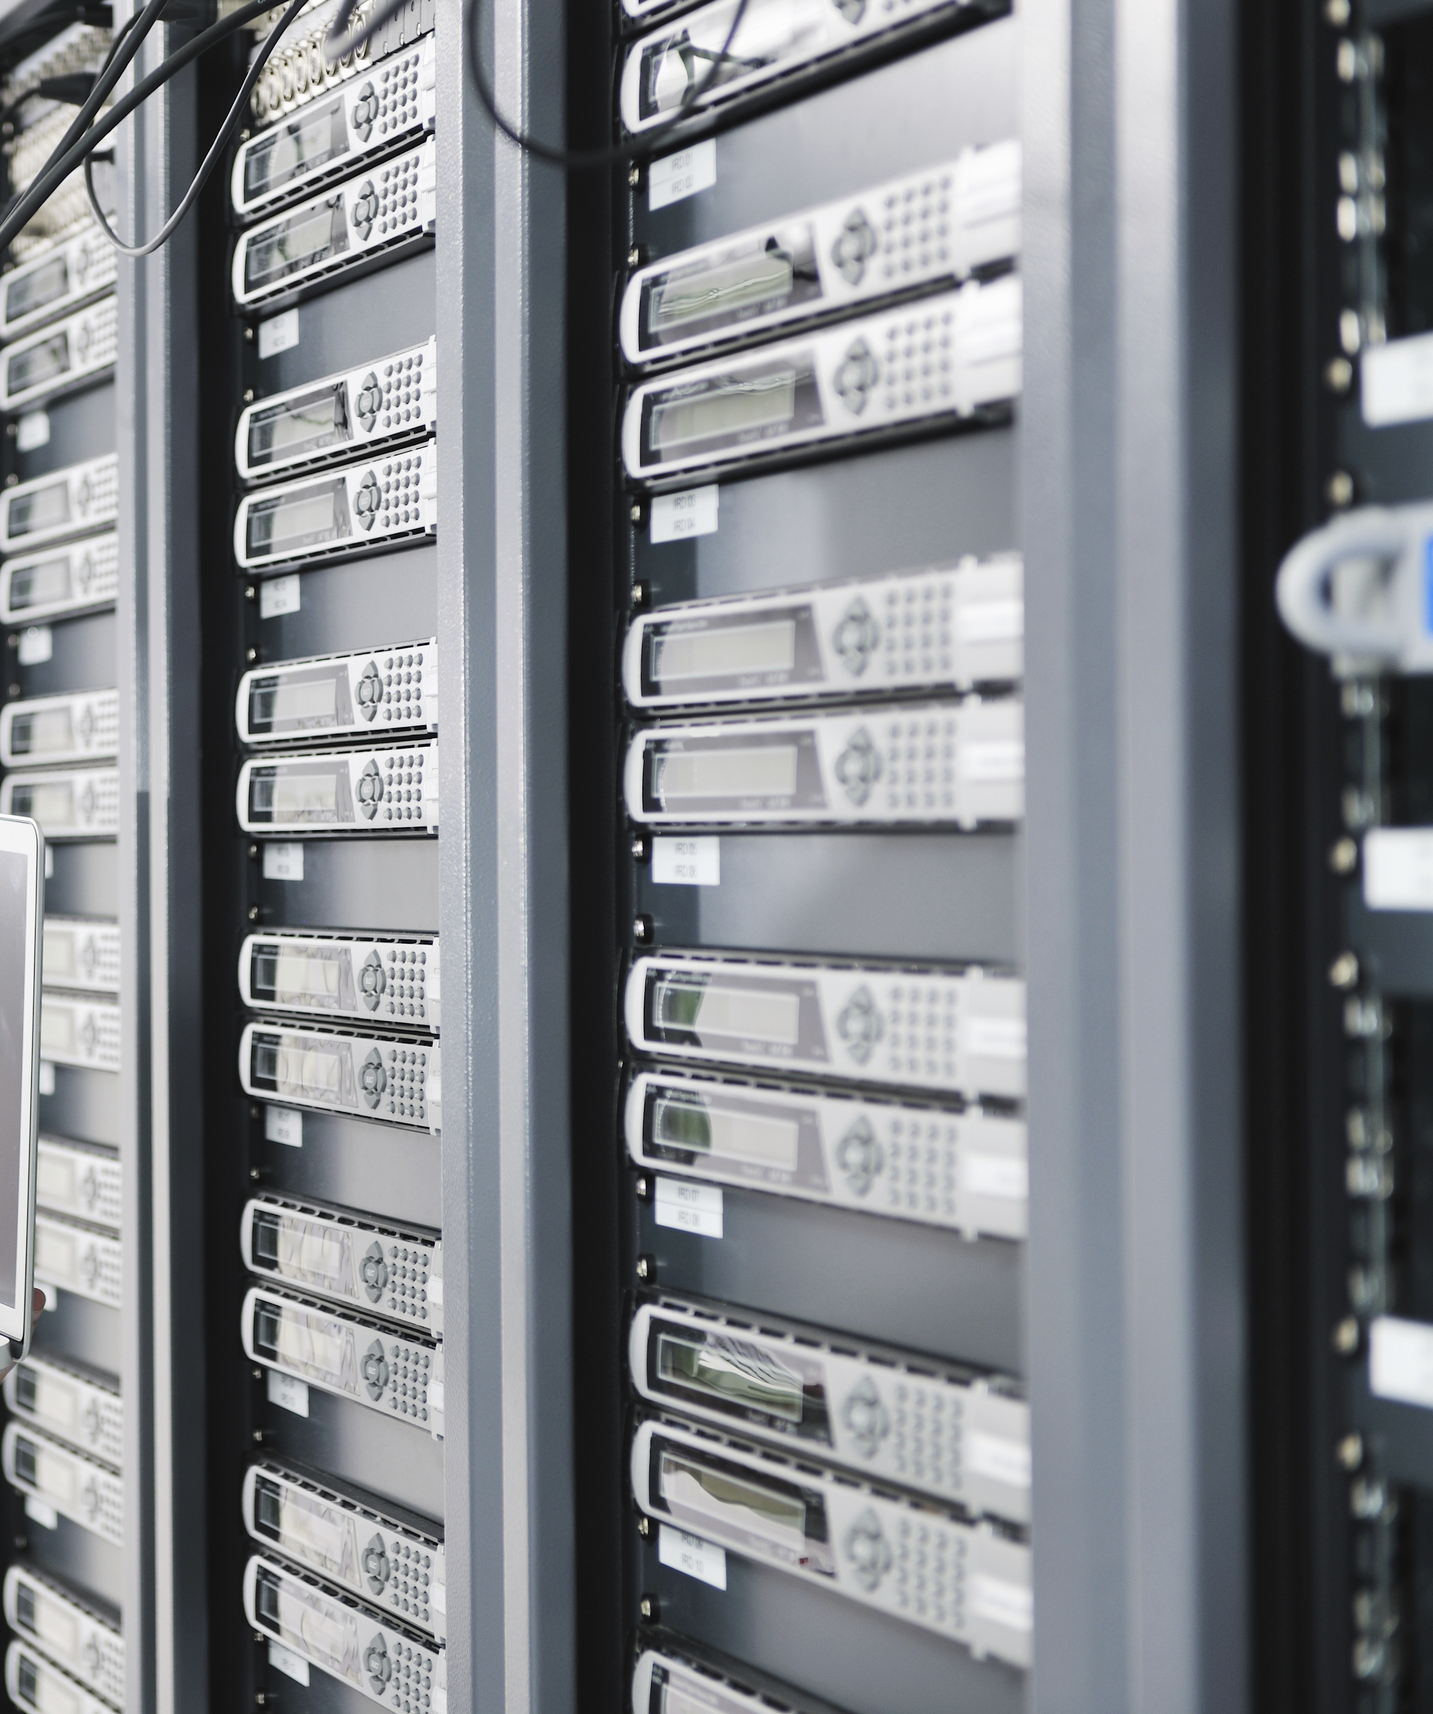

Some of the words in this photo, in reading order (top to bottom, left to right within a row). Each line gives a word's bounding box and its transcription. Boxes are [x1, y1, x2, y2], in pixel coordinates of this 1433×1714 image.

[672, 156, 685, 171] IRD
[672, 178, 685, 195] IRD
[673, 496, 687, 510] IRD
[673, 518, 687, 533] IRD
[675, 842, 688, 855] IRD
[675, 864, 688, 878] IRD
[678, 1186, 691, 1202] IRD
[678, 1210, 691, 1226] IRD
[681, 1552, 694, 1570] IRD
